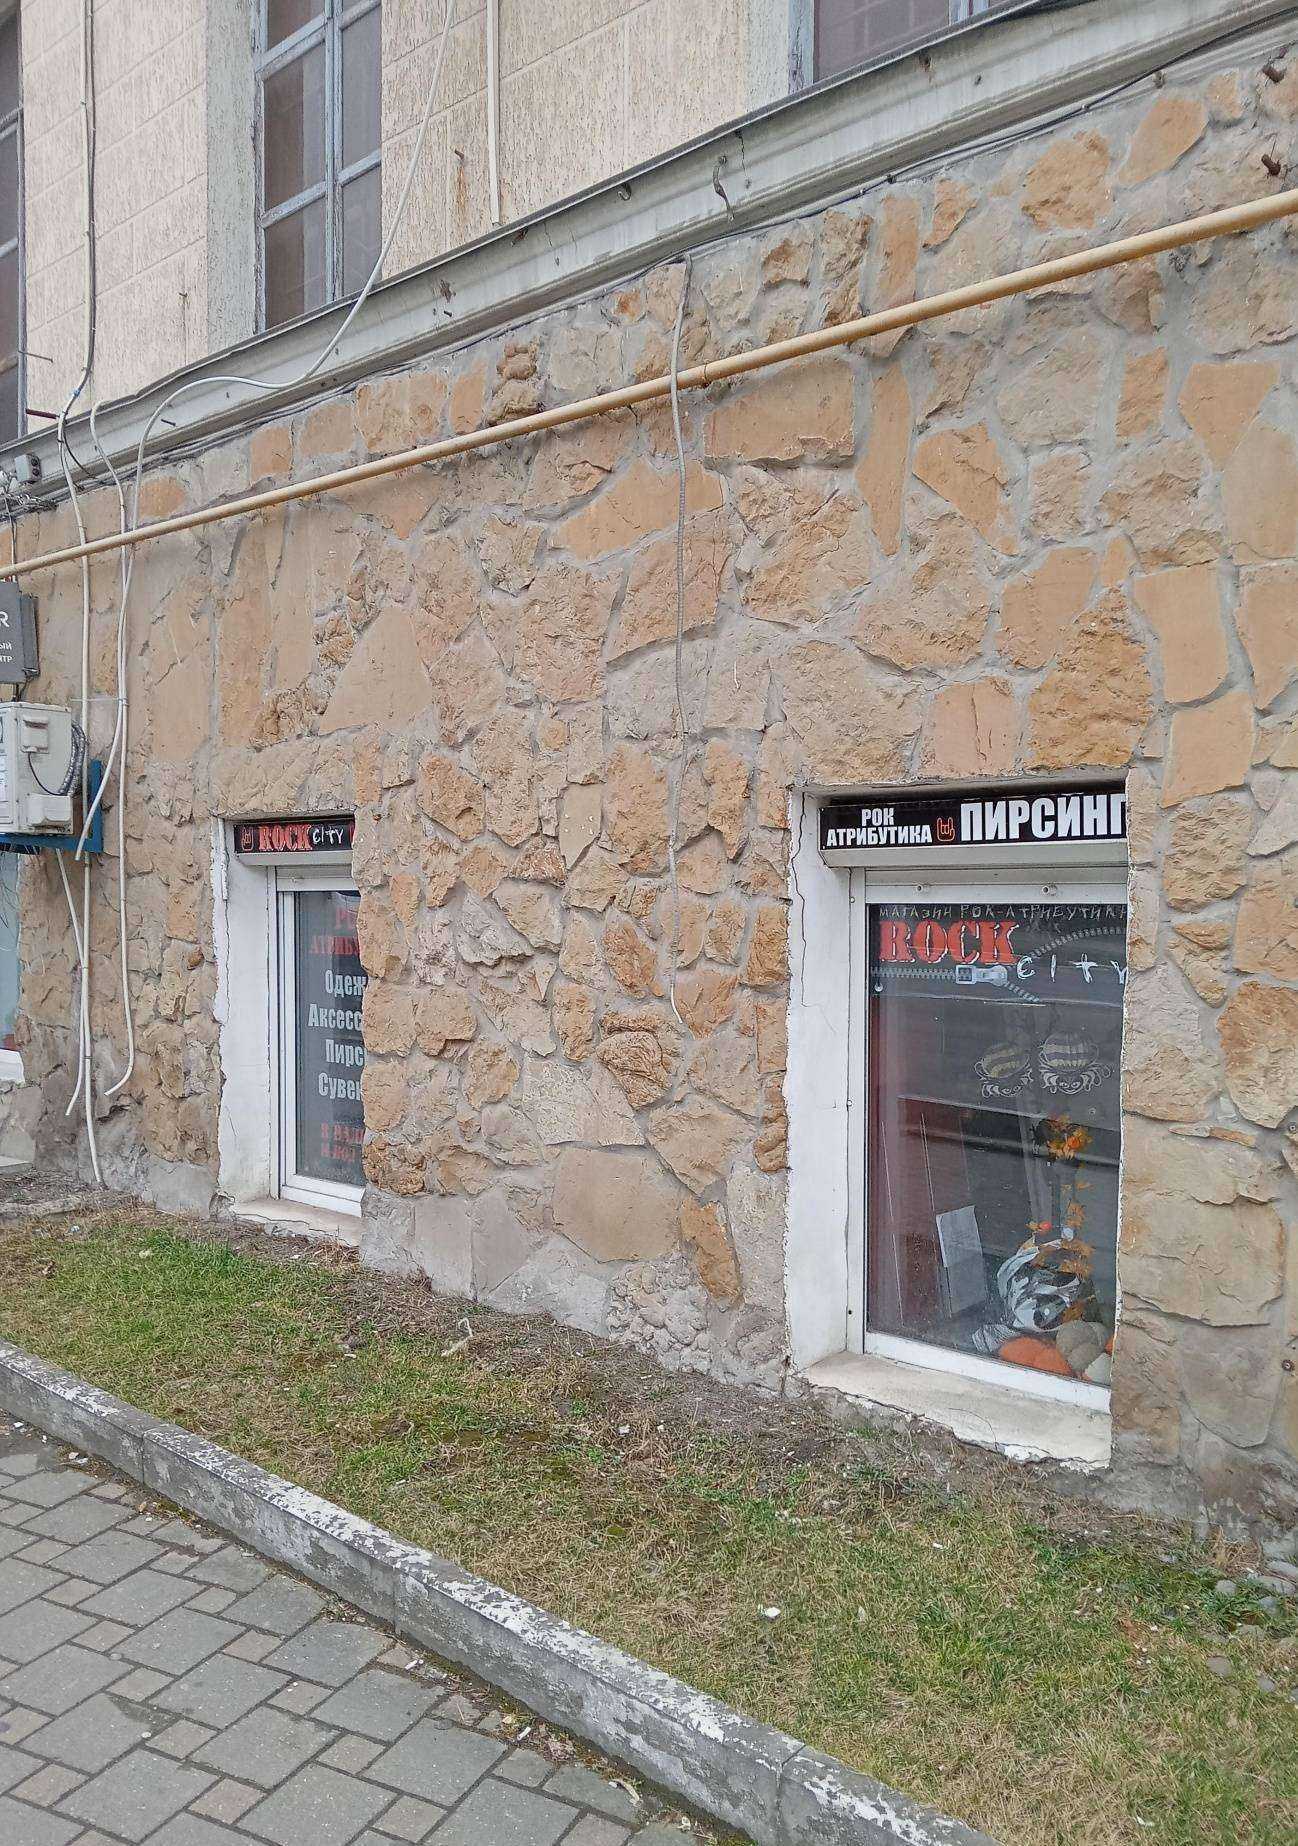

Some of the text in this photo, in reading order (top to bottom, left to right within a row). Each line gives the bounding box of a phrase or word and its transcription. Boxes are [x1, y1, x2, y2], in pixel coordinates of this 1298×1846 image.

[861, 807, 895, 827] РОК
[960, 793, 1127, 841] ПИРСИНГ
[258, 824, 313, 851] ROCK
[826, 824, 933, 847] АТРИБУТИКА
[879, 920, 1020, 965] ROCK
[325, 969, 367, 998] Одеж
[325, 1039, 367, 1067] Пирс
